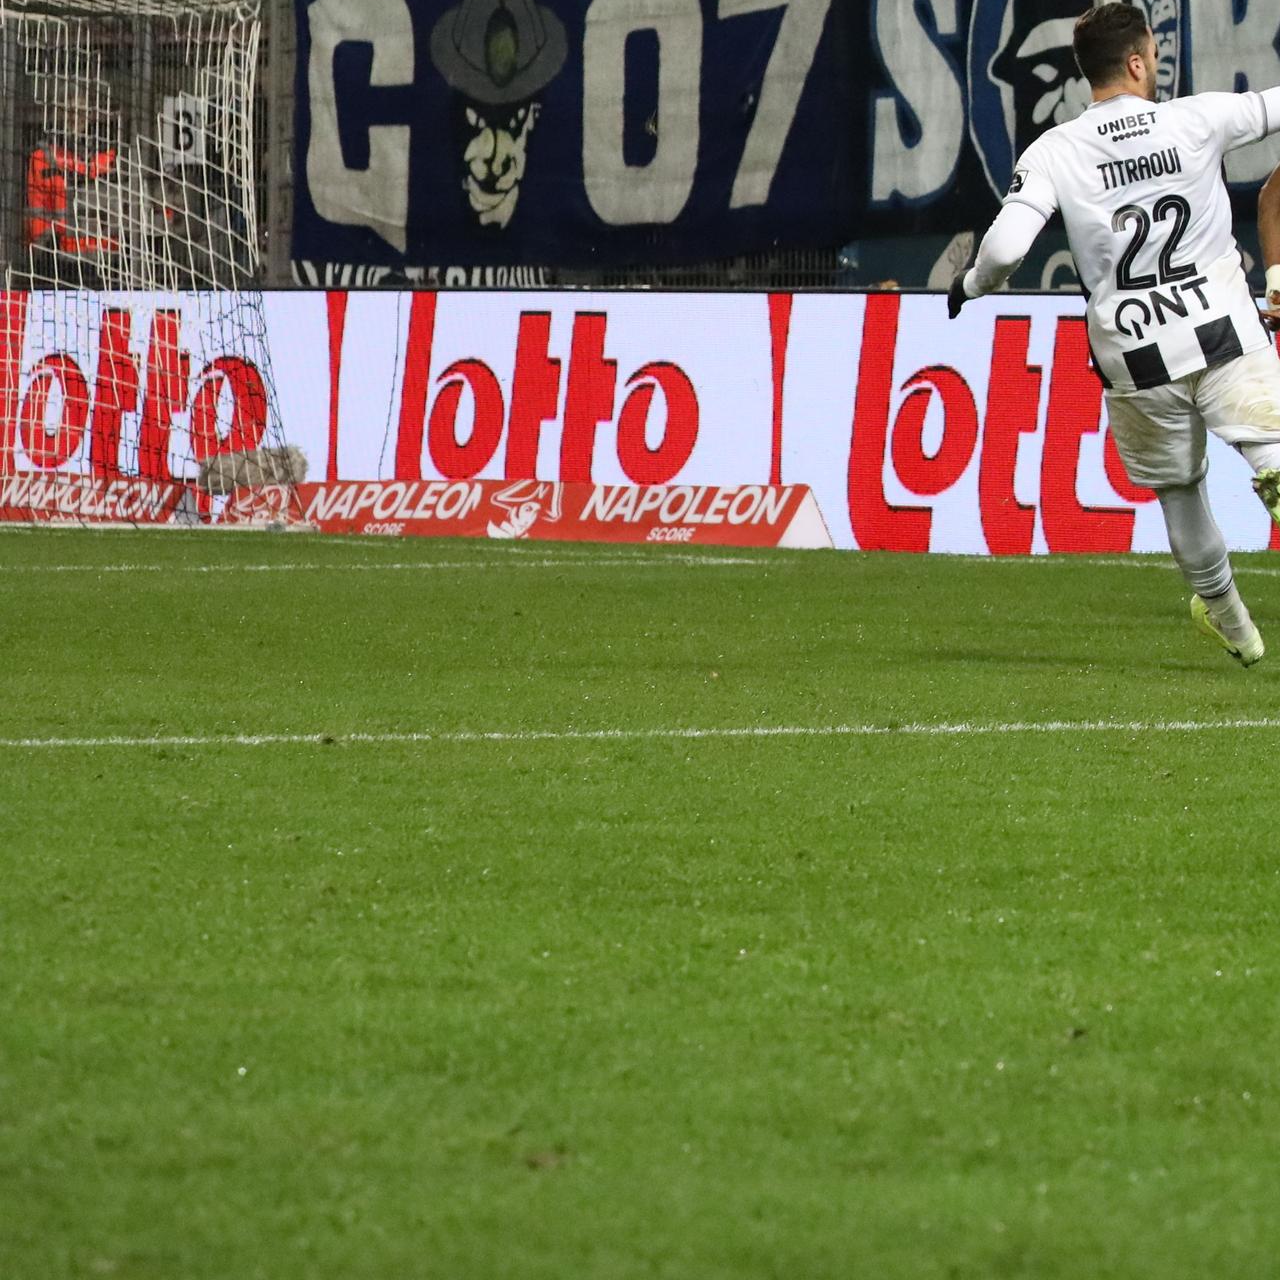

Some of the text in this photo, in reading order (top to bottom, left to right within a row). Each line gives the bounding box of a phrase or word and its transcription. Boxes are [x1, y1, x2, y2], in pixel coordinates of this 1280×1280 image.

[1097, 111, 1157, 136] UNIBET
[1097, 147, 1183, 190] TITRAOUI
[1111, 194, 1198, 291] 22
[580, 485, 792, 526] NAPOLEON
[646, 526, 693, 542] SCORE
